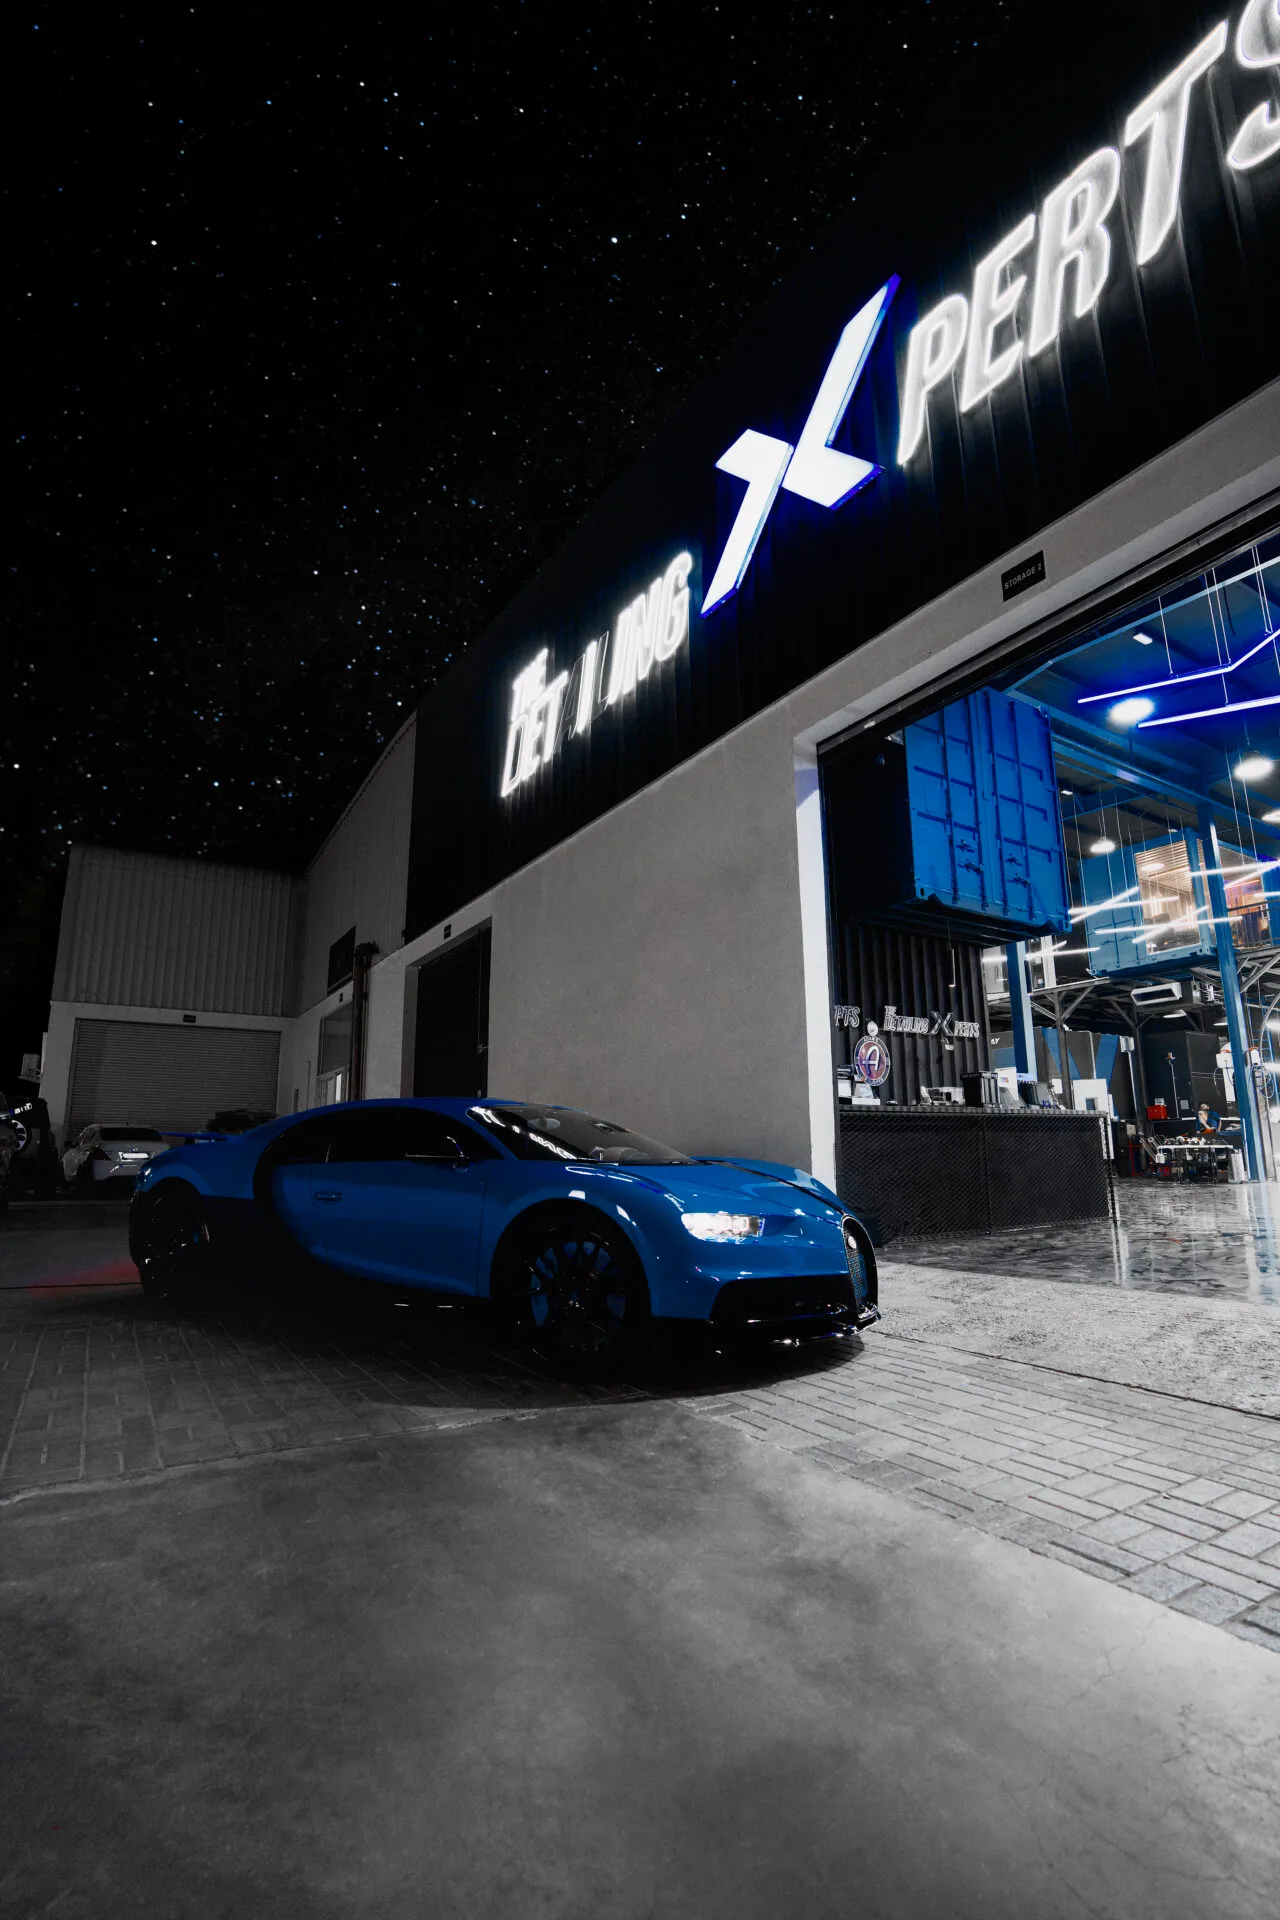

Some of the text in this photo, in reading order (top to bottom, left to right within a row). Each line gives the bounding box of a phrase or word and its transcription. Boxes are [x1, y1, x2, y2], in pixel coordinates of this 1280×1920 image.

[1005, 566, 1036, 590] STORAGE
[501, 552, 693, 798] DETAILING
[883, 1015, 930, 1035] DETAILING
